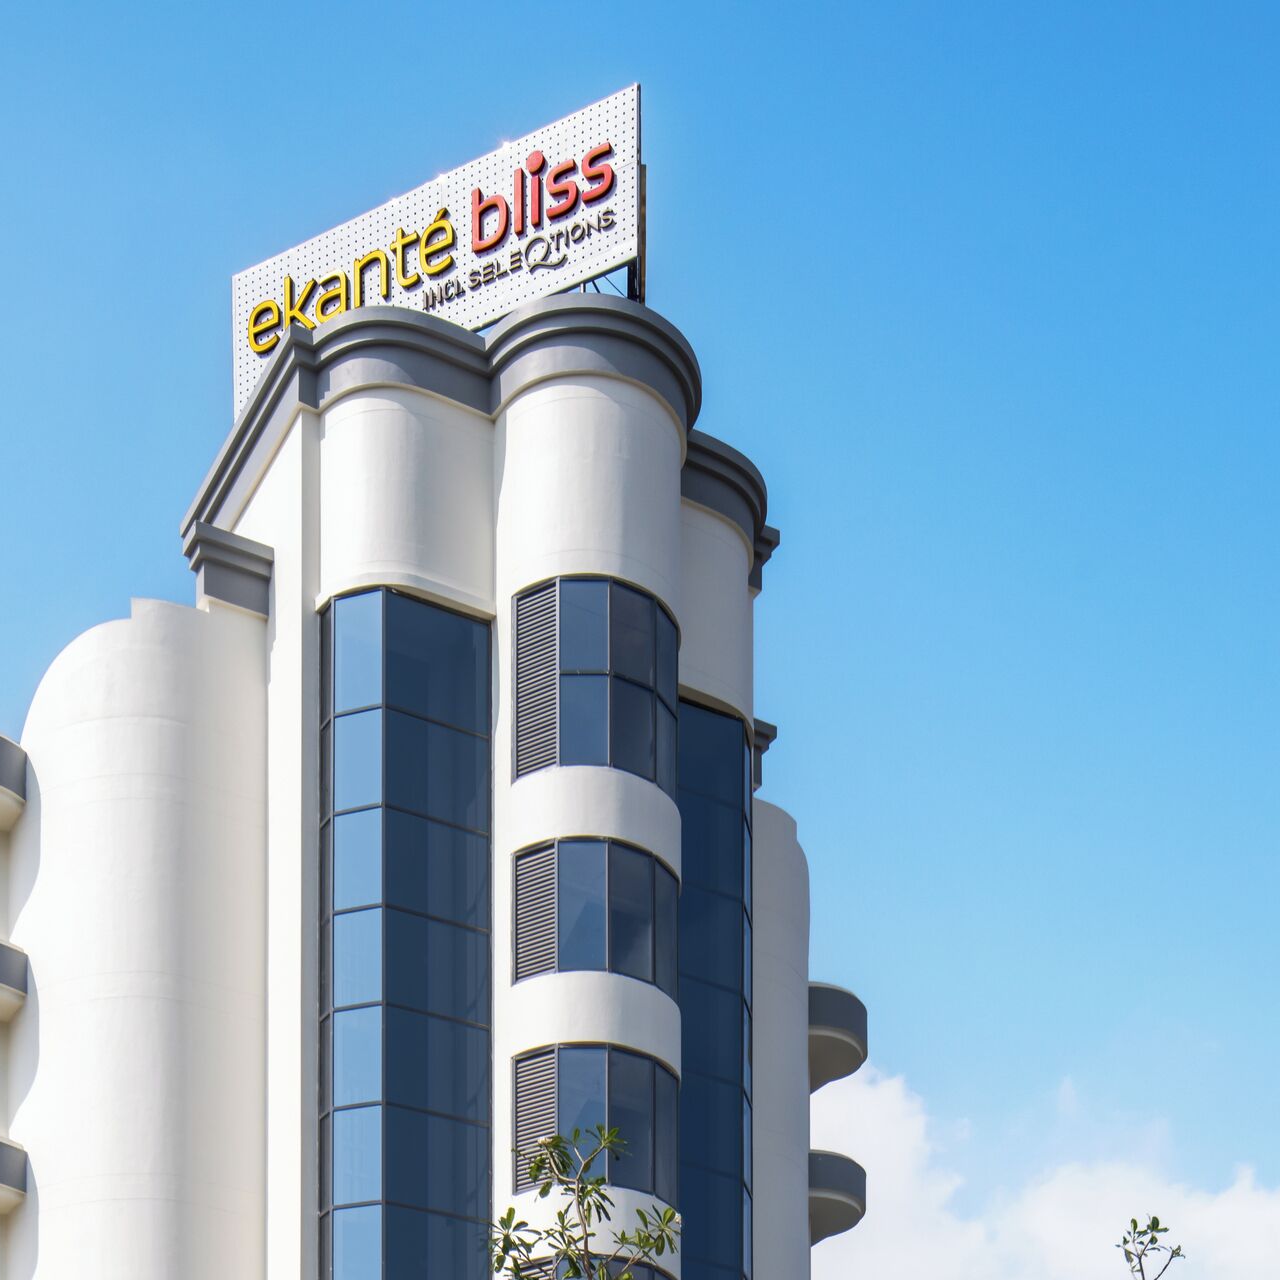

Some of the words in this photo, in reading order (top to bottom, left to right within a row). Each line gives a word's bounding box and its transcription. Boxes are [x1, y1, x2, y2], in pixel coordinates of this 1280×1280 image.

[248, 208, 455, 353] ekanté
[472, 142, 614, 252] bliss
[468, 208, 614, 288] SELEQTIONS
